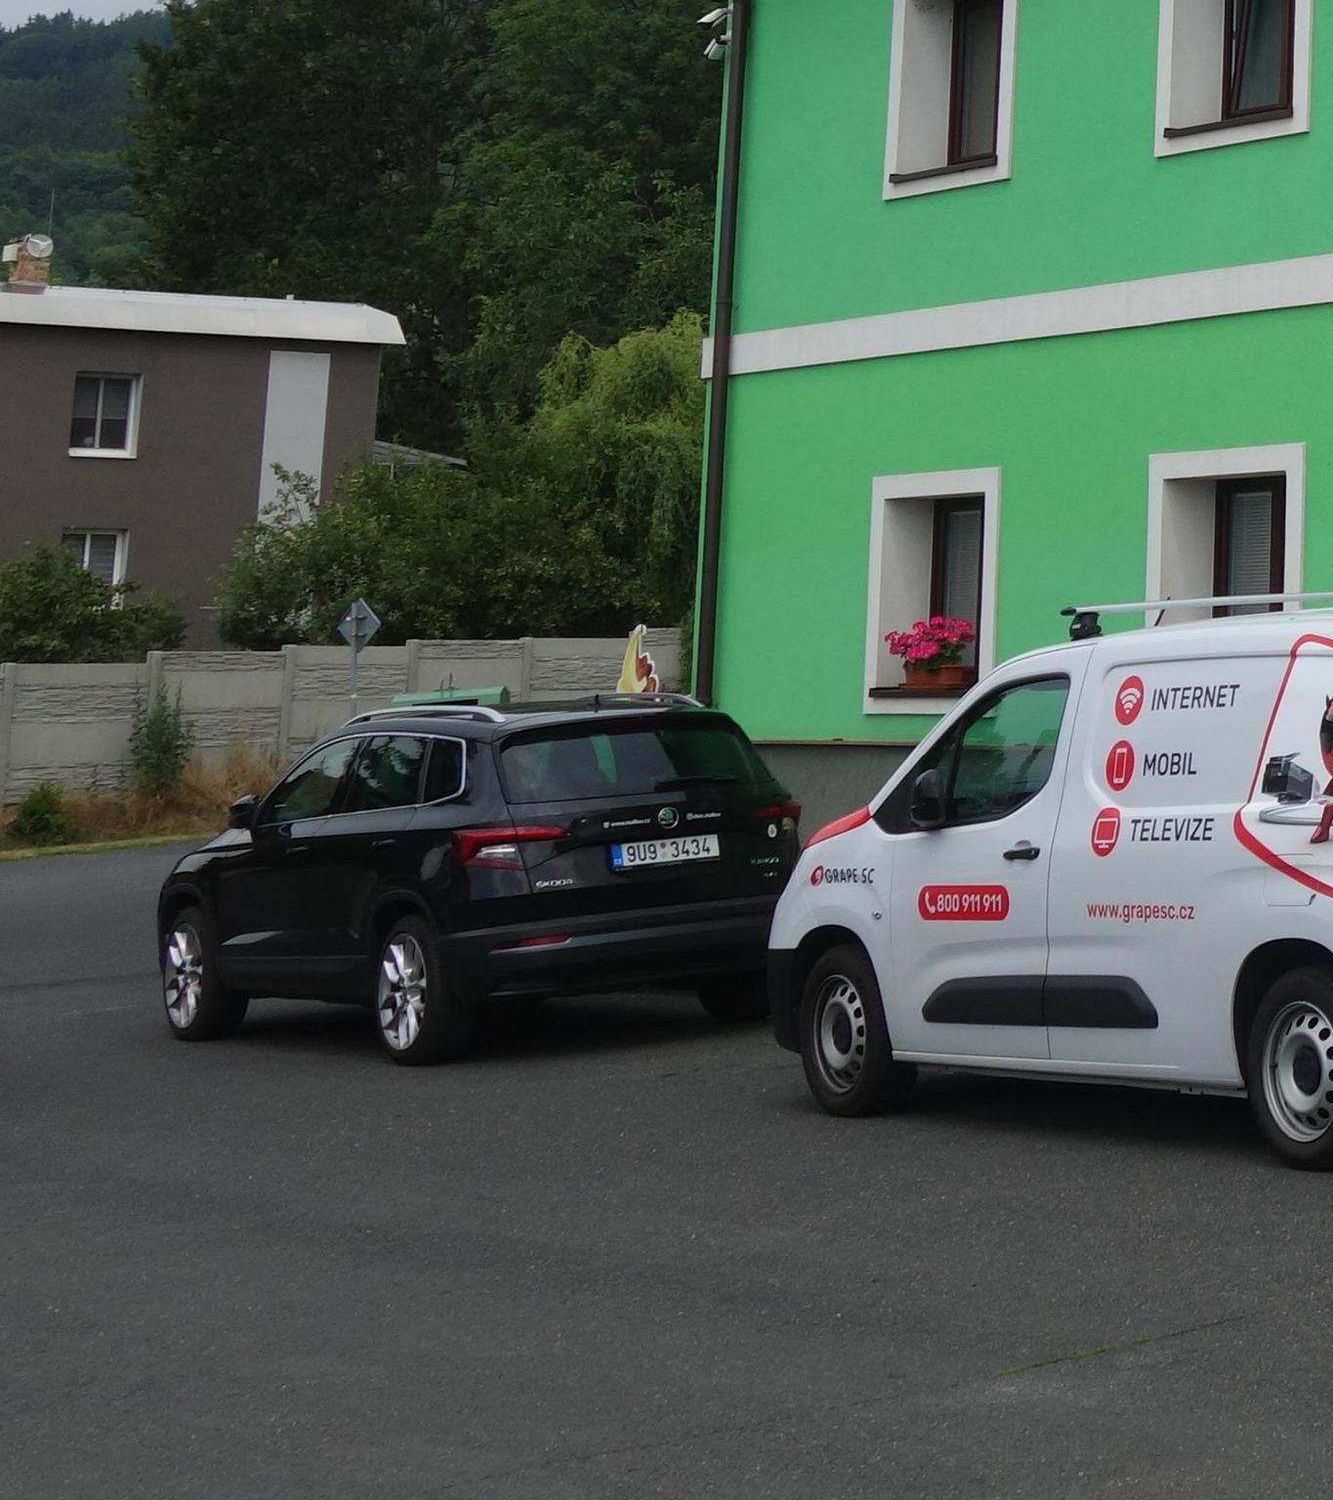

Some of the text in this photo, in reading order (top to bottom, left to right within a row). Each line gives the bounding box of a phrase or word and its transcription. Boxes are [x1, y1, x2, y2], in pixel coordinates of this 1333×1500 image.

[1151, 684, 1240, 711] INTERNET
[1142, 752, 1197, 776] MOBIL
[1131, 818, 1215, 842] TELEVIZE
[626, 837, 711, 863] 9U9 3434
[824, 868, 875, 884] GRAPE SC
[936, 893, 1002, 912] 800 911 911
[1087, 904, 1195, 923] www.grapesc.cz
